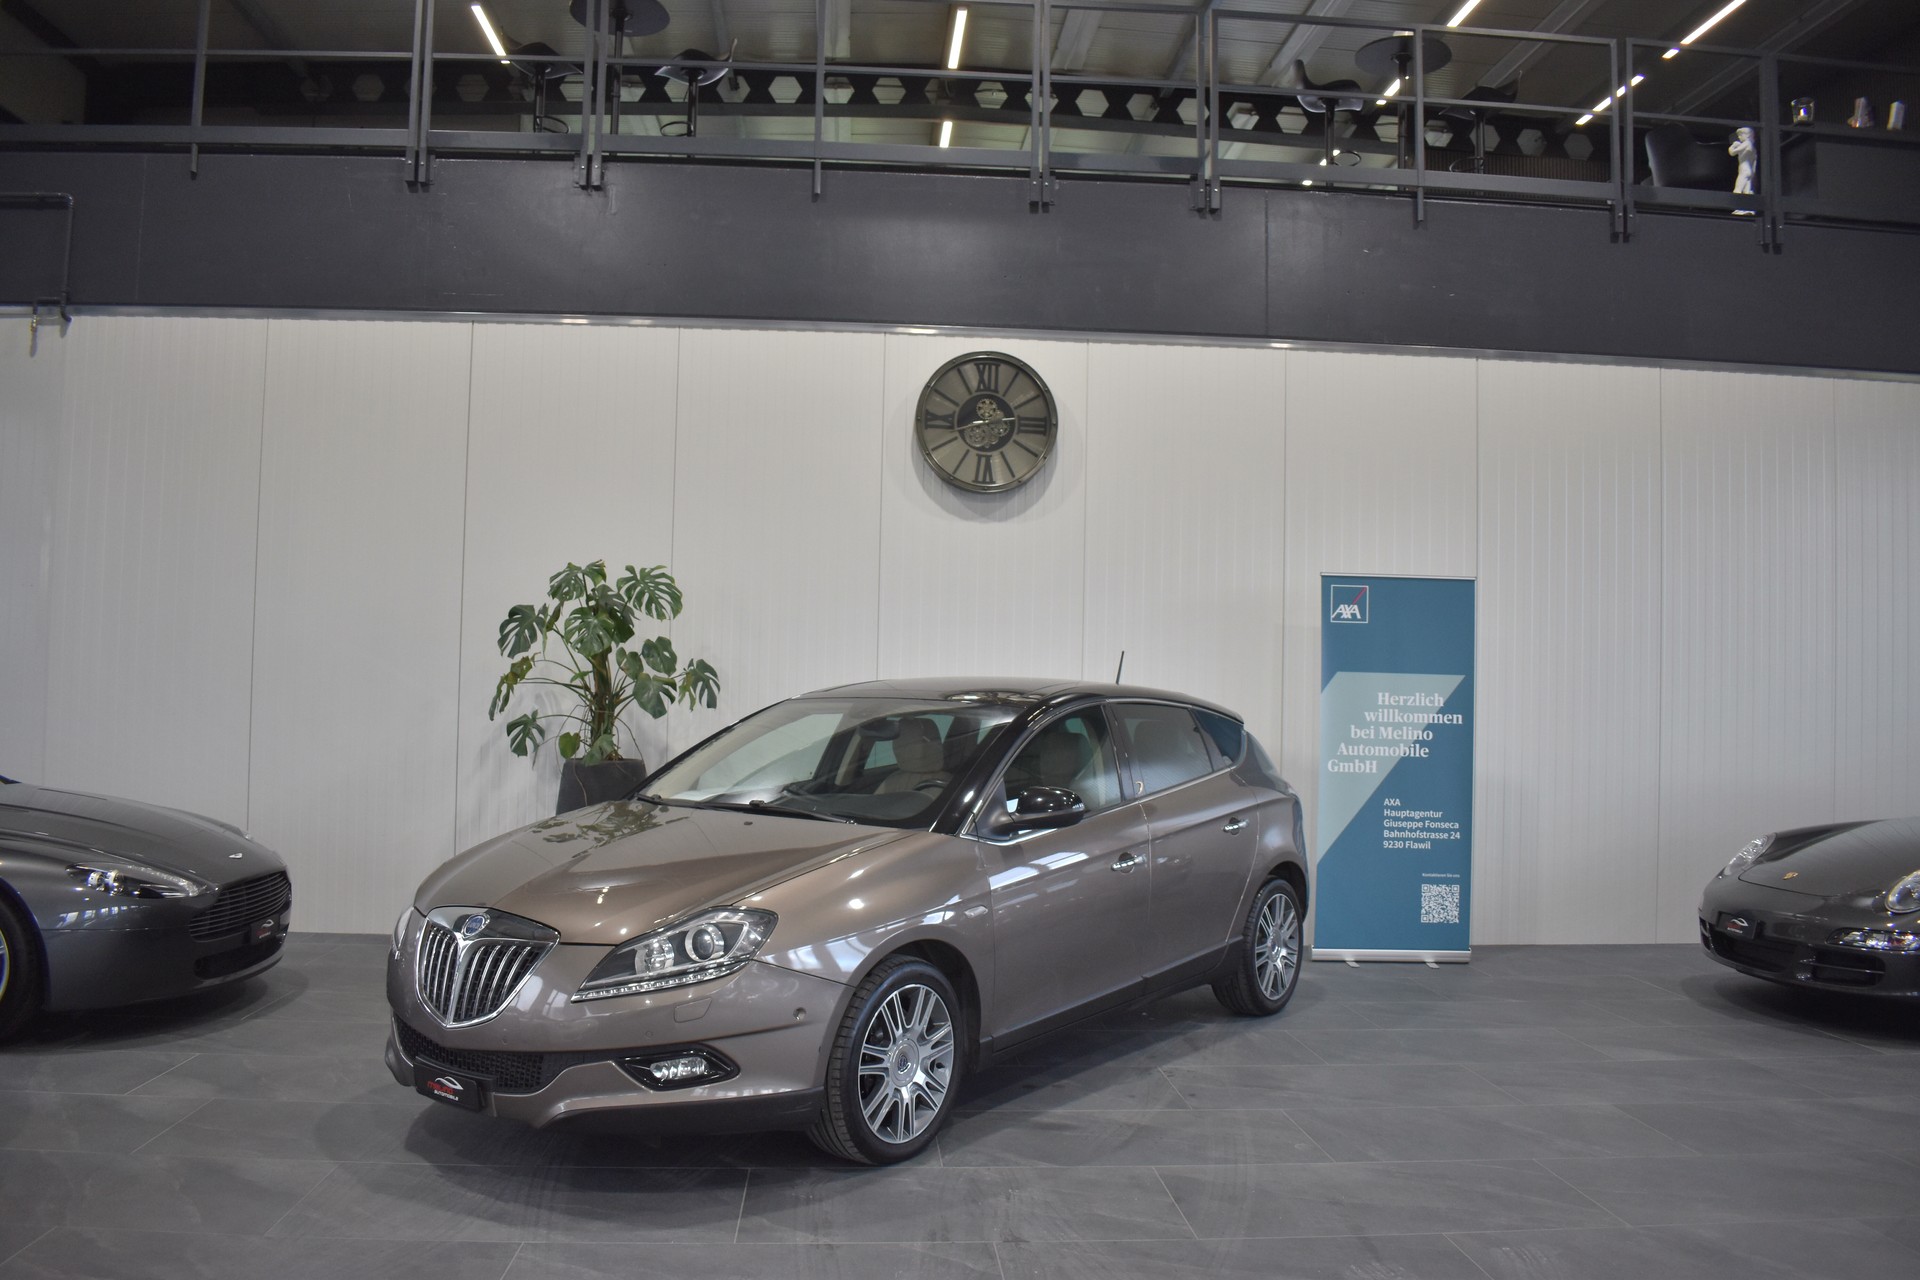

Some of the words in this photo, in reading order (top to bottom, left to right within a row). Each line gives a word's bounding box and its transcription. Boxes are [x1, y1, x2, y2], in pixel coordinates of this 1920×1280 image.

[974, 362, 1001, 393] XII
[1016, 416, 1048, 436] III
[1331, 604, 1362, 619] AXA
[1377, 692, 1444, 707] Herzlich
[1364, 708, 1463, 724] willkommen
[1351, 725, 1375, 739] bei
[1379, 726, 1433, 741] Melino
[1337, 742, 1429, 758] Automobile
[1327, 759, 1377, 773] GmbH
[1383, 798, 1401, 806] AXA
[1383, 809, 1443, 819] Hauptagentur
[1383, 819, 1423, 829] Giuseppe
[1425, 820, 1459, 829] Fonseca
[1383, 830, 1449, 839] Bahnhofstrasse
[1450, 831, 1460, 840] 24
[1383, 840, 1404, 849] 9230
[1405, 841, 1431, 849] Flawil
